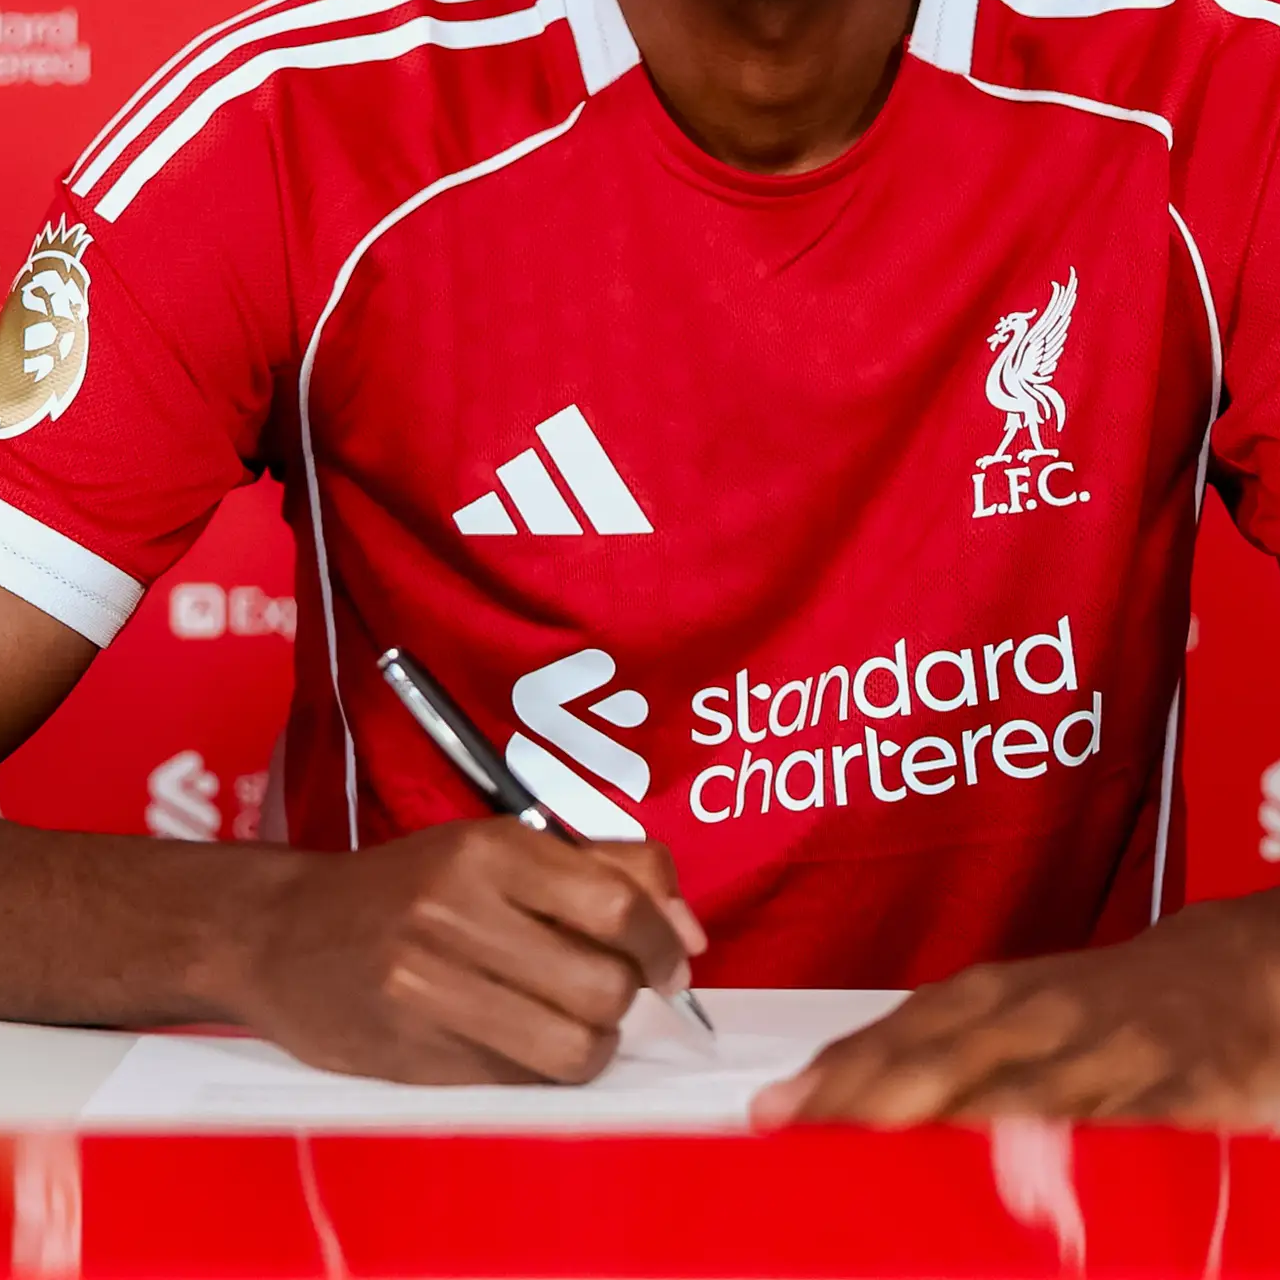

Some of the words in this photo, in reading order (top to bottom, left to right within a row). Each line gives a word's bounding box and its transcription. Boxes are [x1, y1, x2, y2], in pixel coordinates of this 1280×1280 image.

[971, 461, 1091, 519] L.F.C.
[691, 615, 1078, 745] standard
[689, 690, 1102, 824] chartered
